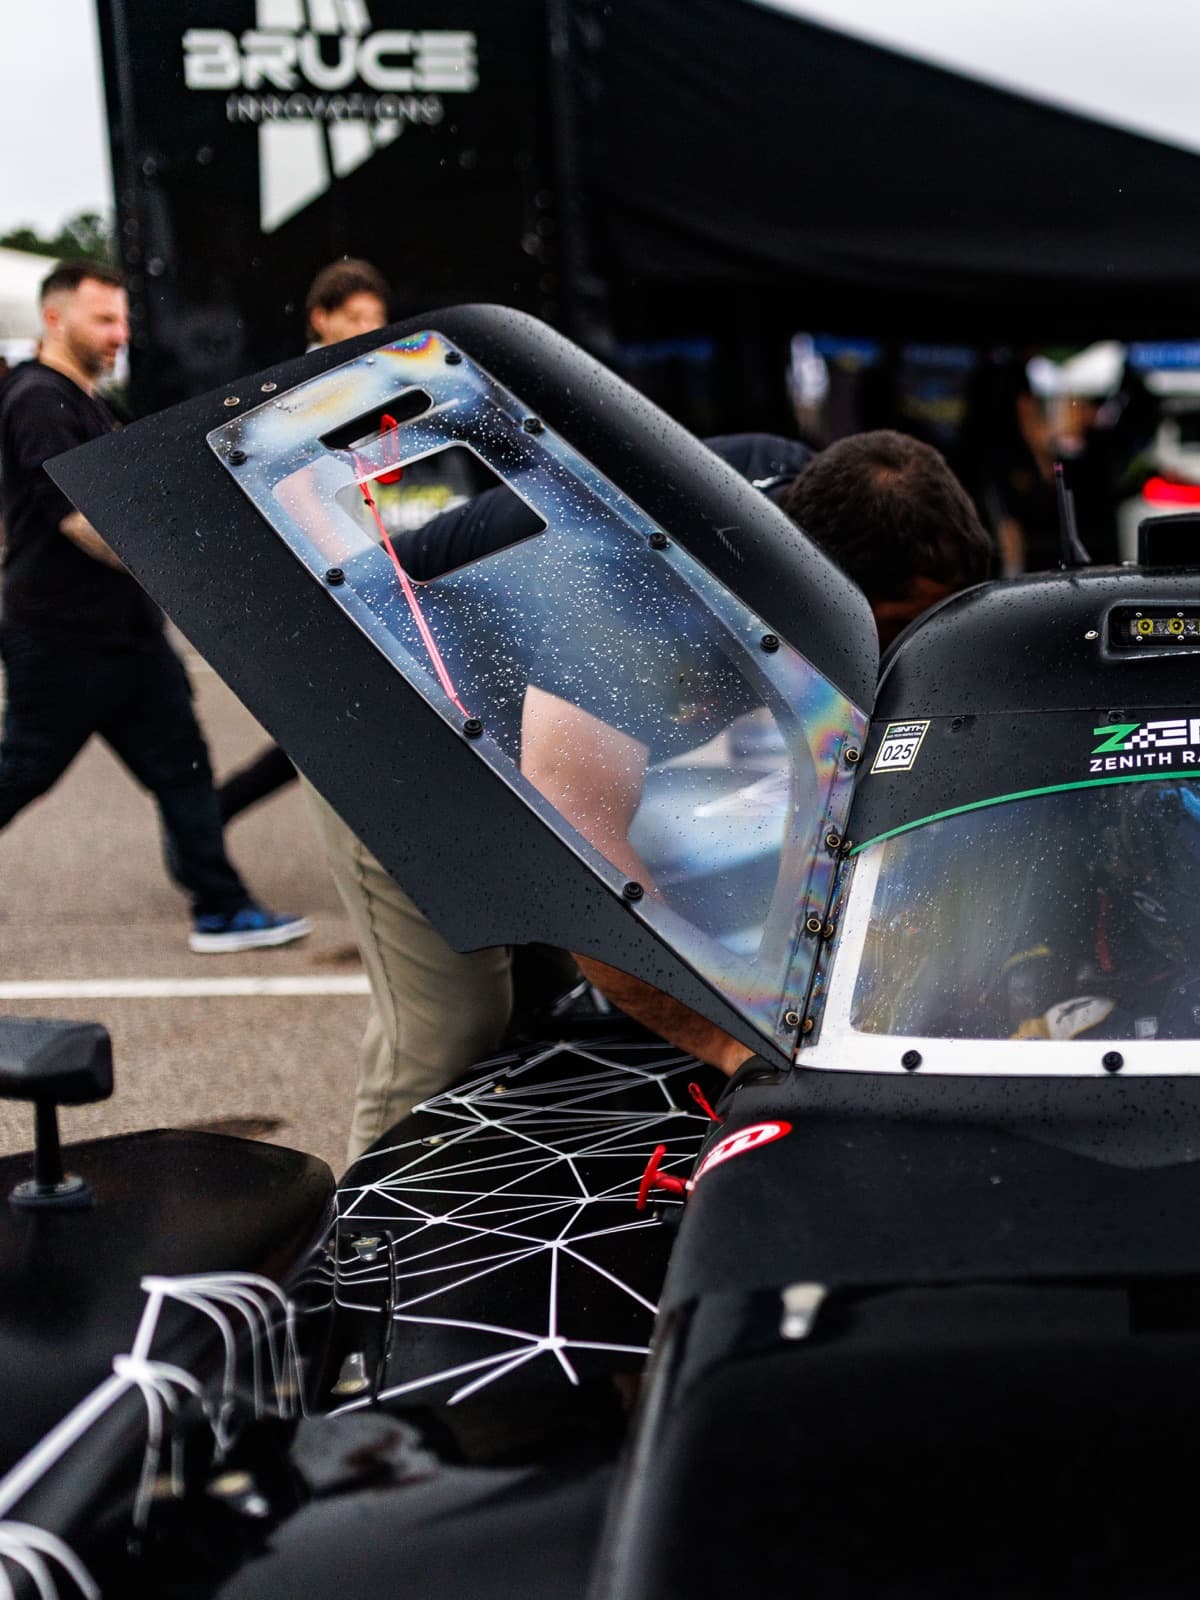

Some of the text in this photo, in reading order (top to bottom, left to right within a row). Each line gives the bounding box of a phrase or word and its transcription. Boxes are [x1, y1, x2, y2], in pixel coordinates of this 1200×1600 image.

[182, 29, 478, 91] BRUCE
[226, 93, 444, 124] INNOVATIONS
[883, 744, 914, 761] 025
[1090, 752, 1172, 772] ZENITH
